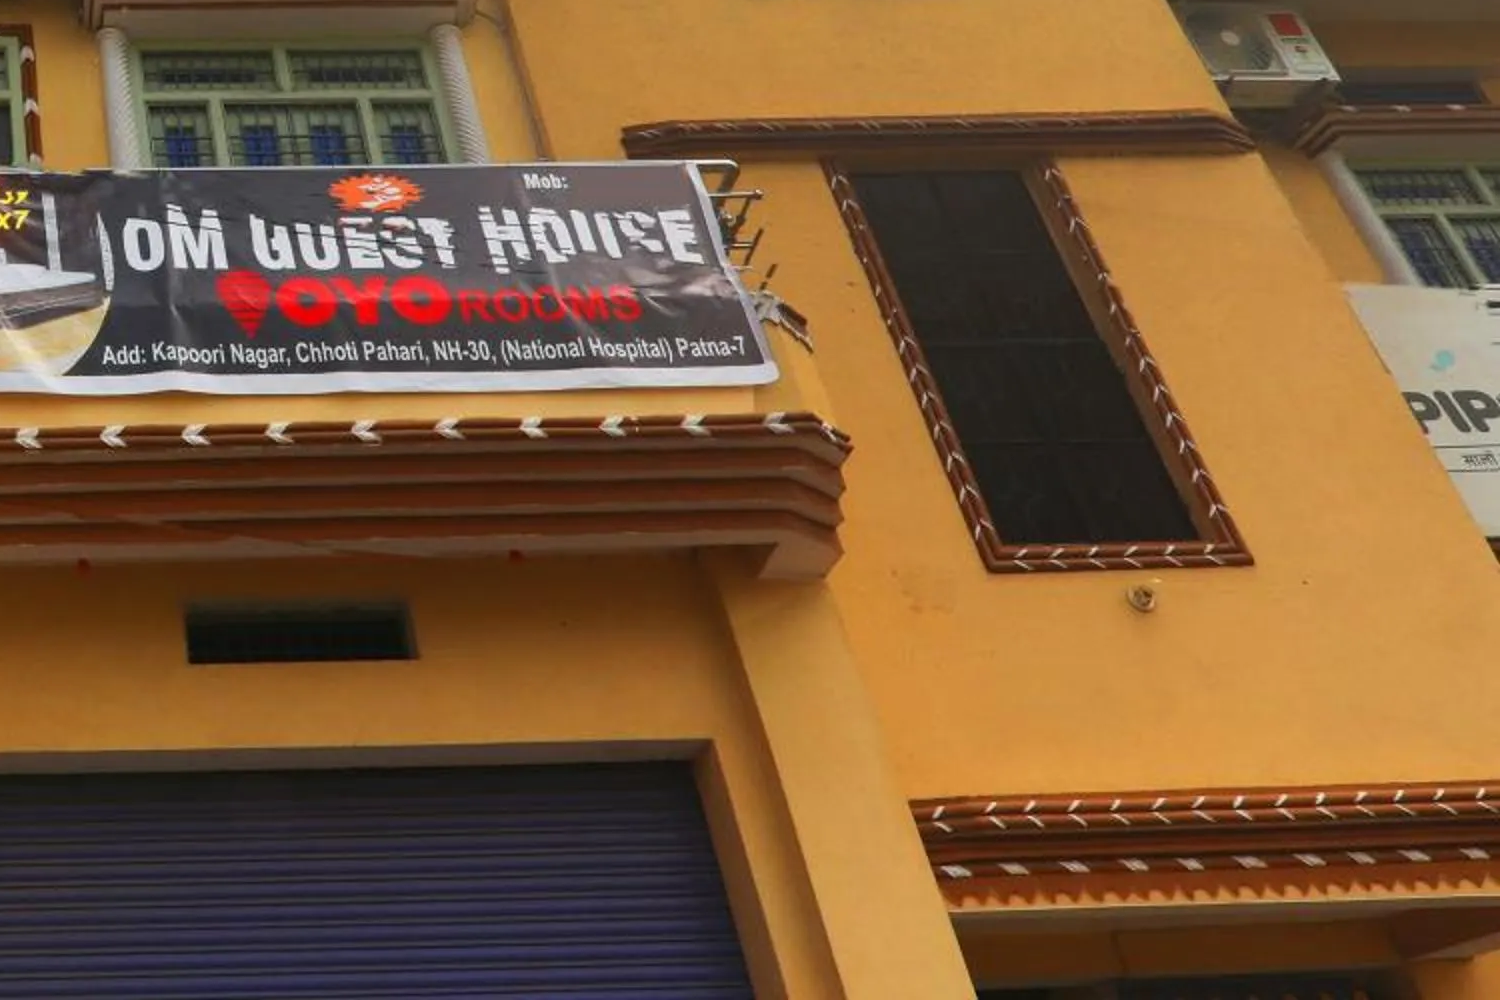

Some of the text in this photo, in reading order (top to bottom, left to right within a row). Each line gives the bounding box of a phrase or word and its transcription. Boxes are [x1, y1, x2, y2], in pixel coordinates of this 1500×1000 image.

[523, 173, 569, 190] Mob:
[122, 203, 229, 272] OM
[275, 274, 643, 326] OYO ROOMS
[102, 335, 745, 368] Add: Kapoori Nagar, Chhoti Pahari, NH-30, (National Hospital) Patna-7
[1401, 390, 1500, 435] PIP
